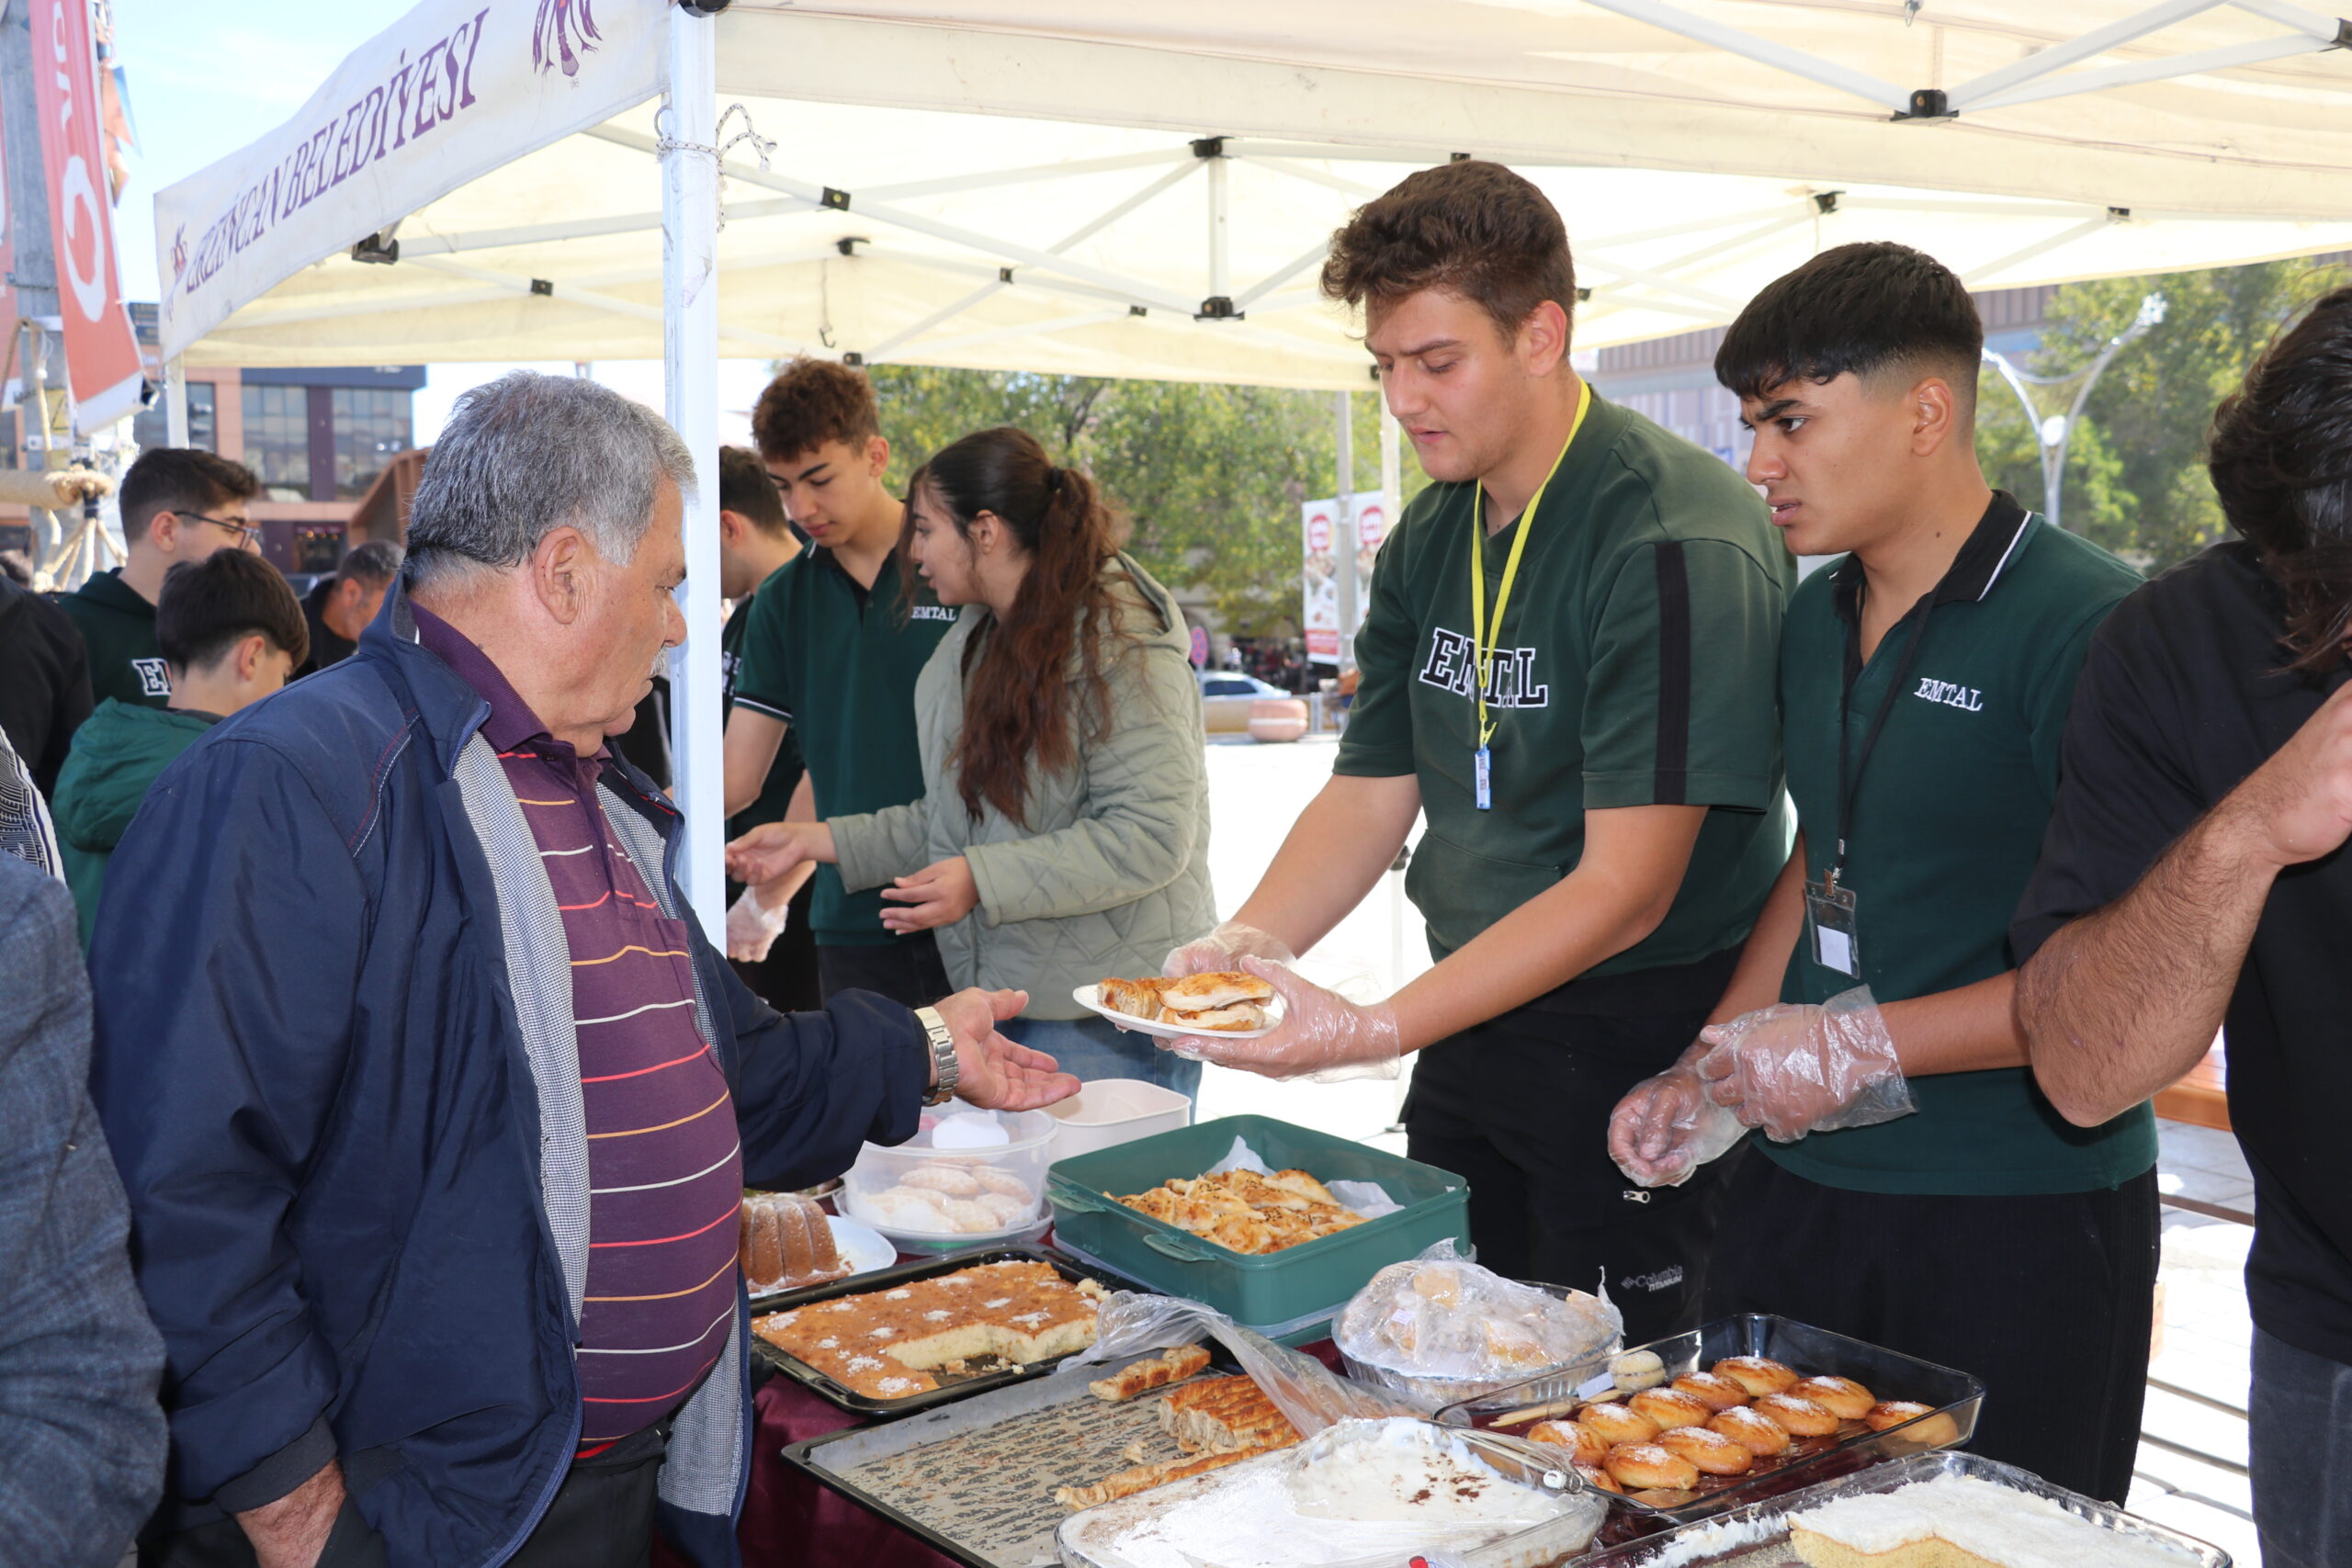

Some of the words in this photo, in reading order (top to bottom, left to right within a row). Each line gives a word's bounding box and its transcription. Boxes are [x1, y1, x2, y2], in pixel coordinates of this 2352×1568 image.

[911, 605, 956, 622] EMTAL
[1914, 678, 1984, 712] EMTAL
[1635, 1264, 1683, 1288] Columbia
